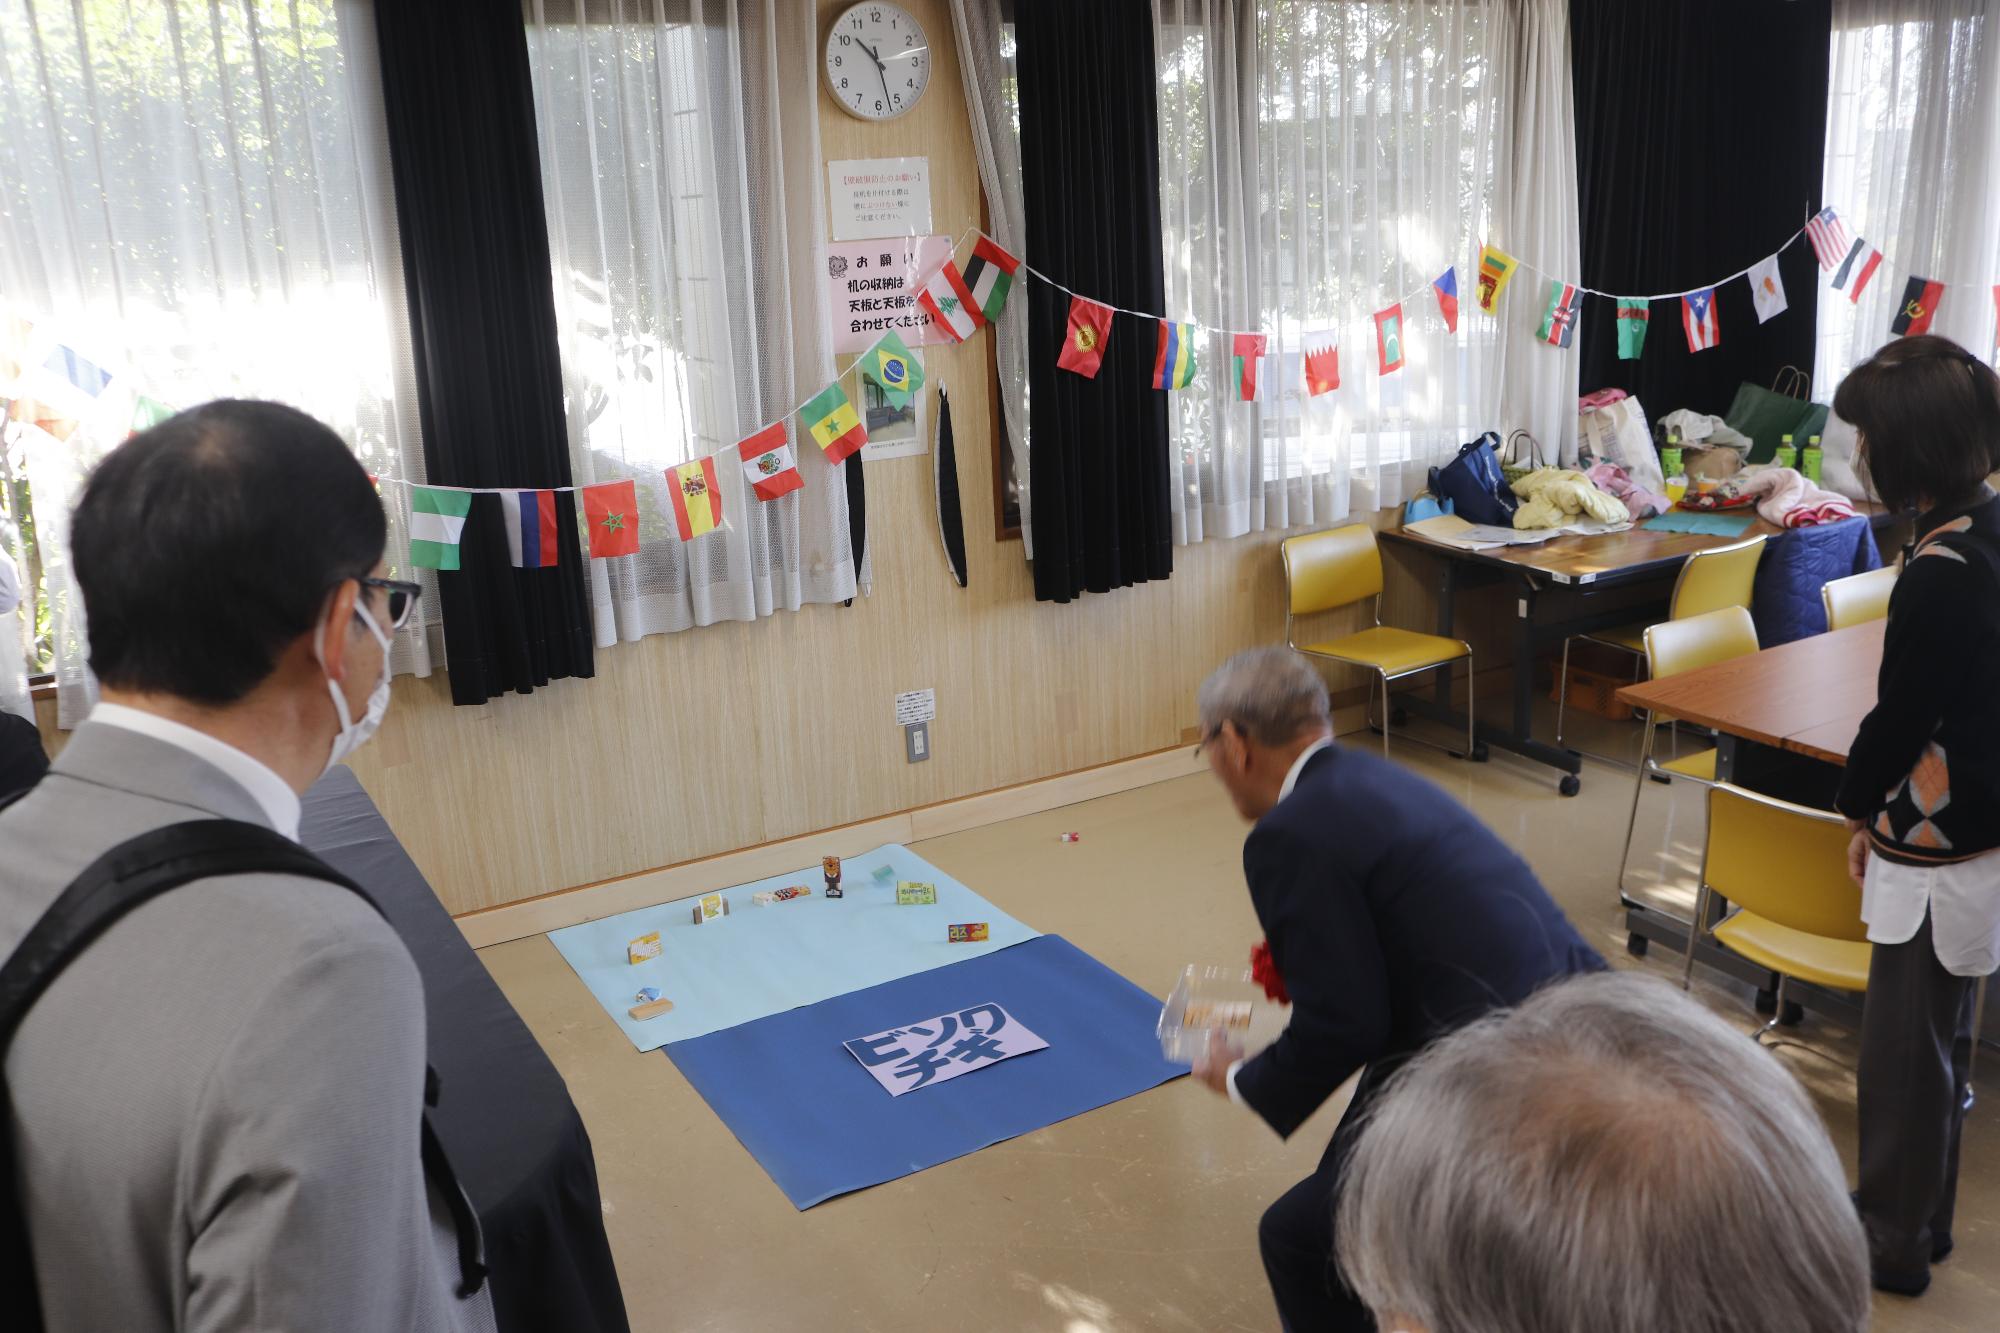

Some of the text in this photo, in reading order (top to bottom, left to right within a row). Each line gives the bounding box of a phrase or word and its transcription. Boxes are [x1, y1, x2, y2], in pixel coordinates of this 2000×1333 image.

[870, 12, 881, 23] 12
[852, 19, 862, 29] 11
[839, 35, 851, 46] 10
[905, 36, 913, 46] 2
[835, 56, 842, 67] 9
[911, 57, 919, 67] 3
[841, 78, 848, 88] 8
[907, 78, 913, 89] 4
[856, 93, 863, 104] 7
[893, 94, 901, 104] 5
[875, 100, 882, 111] 6
[848, 276, 904, 293] 机の収納は
